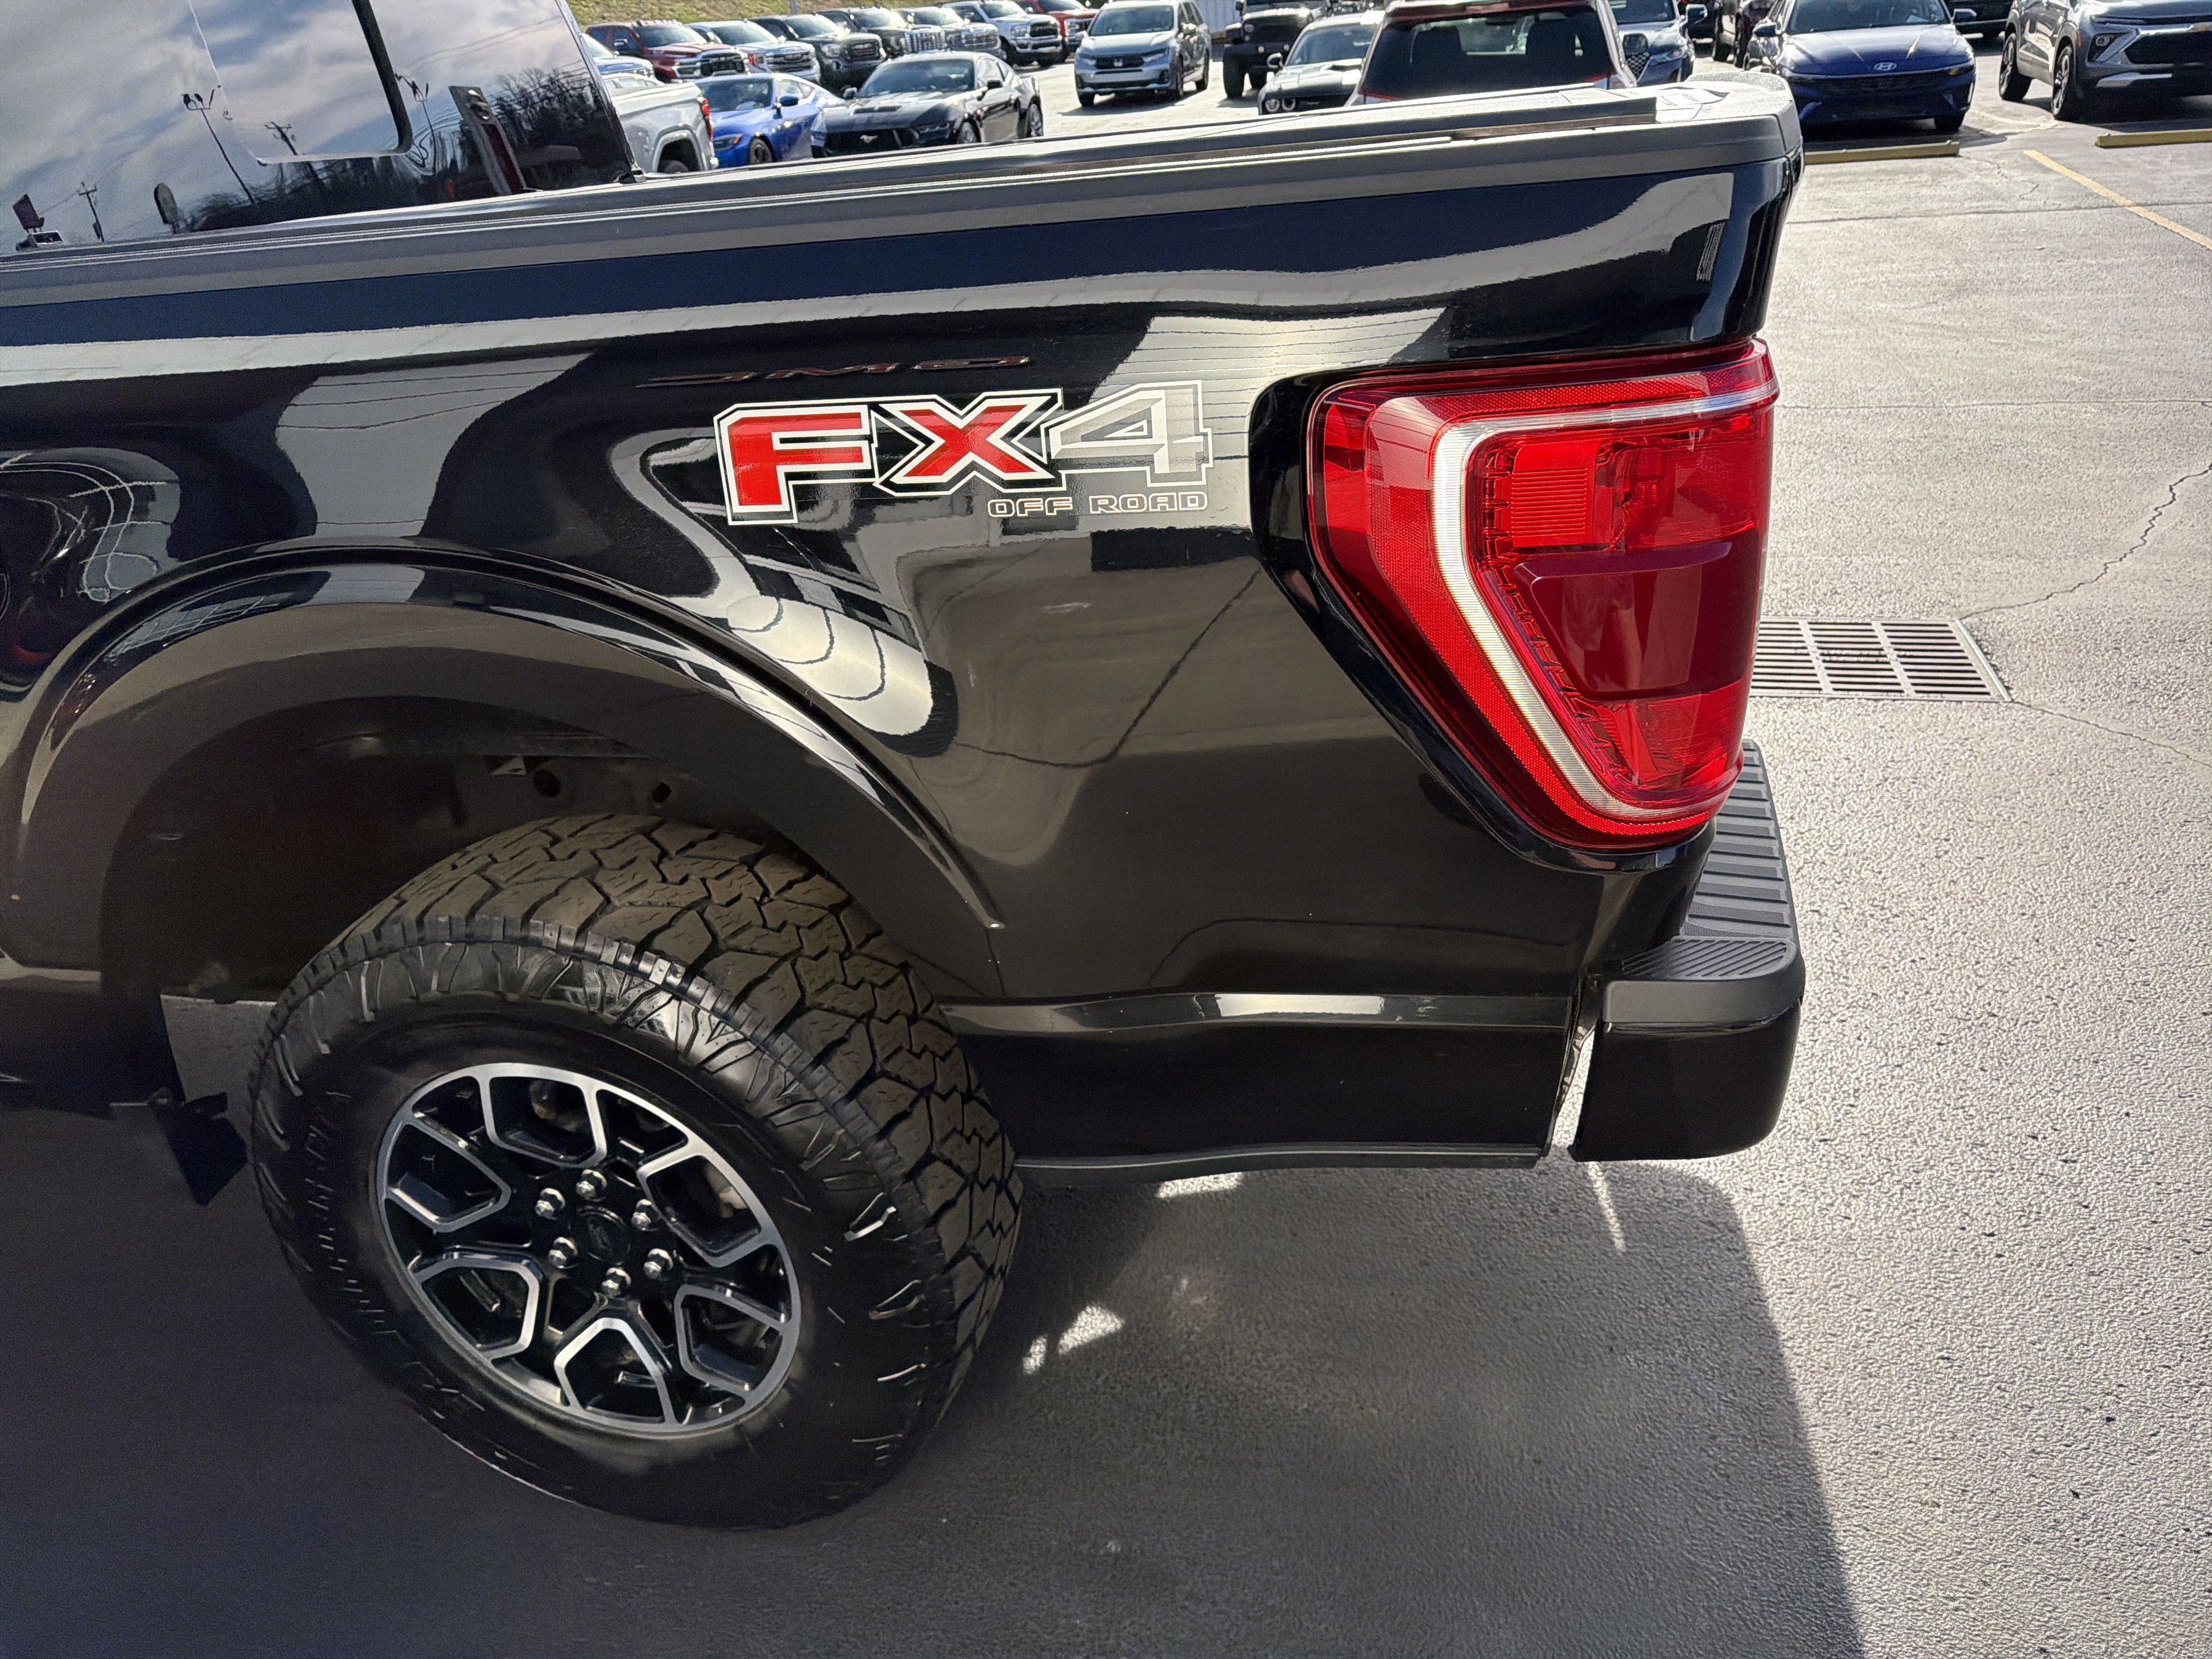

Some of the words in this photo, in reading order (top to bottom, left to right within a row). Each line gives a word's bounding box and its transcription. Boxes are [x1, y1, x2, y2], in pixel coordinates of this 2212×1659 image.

[713, 380, 1214, 526] FX4
[988, 496, 1073, 517] OFF
[1088, 491, 1207, 515] ROAD
